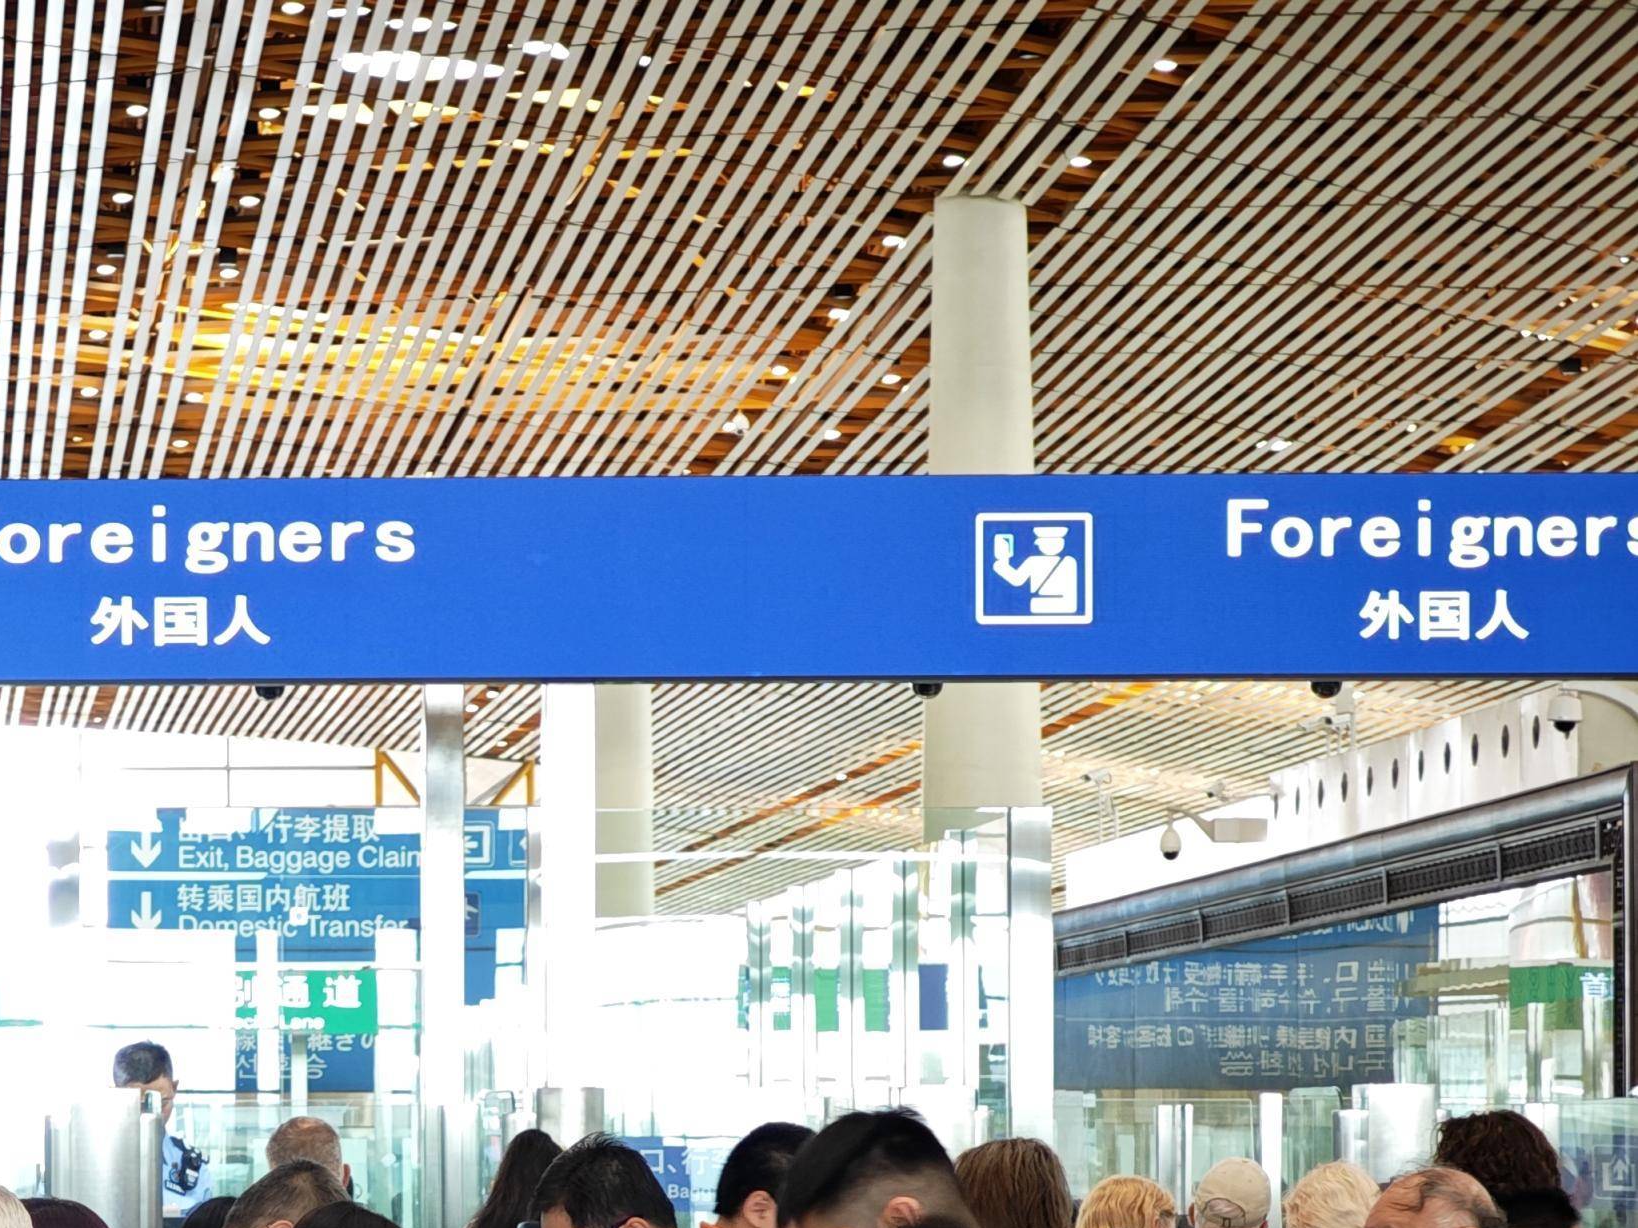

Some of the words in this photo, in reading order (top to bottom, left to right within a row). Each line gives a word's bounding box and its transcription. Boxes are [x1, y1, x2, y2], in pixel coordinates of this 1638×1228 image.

[1226, 498, 1638, 569] Foreigner
[90, 594, 271, 647] 外国人
[1359, 588, 1530, 641] 外国人
[178, 845, 229, 870] Exit,
[235, 845, 351, 873] Baggage
[176, 883, 351, 913] 转乘国内航班
